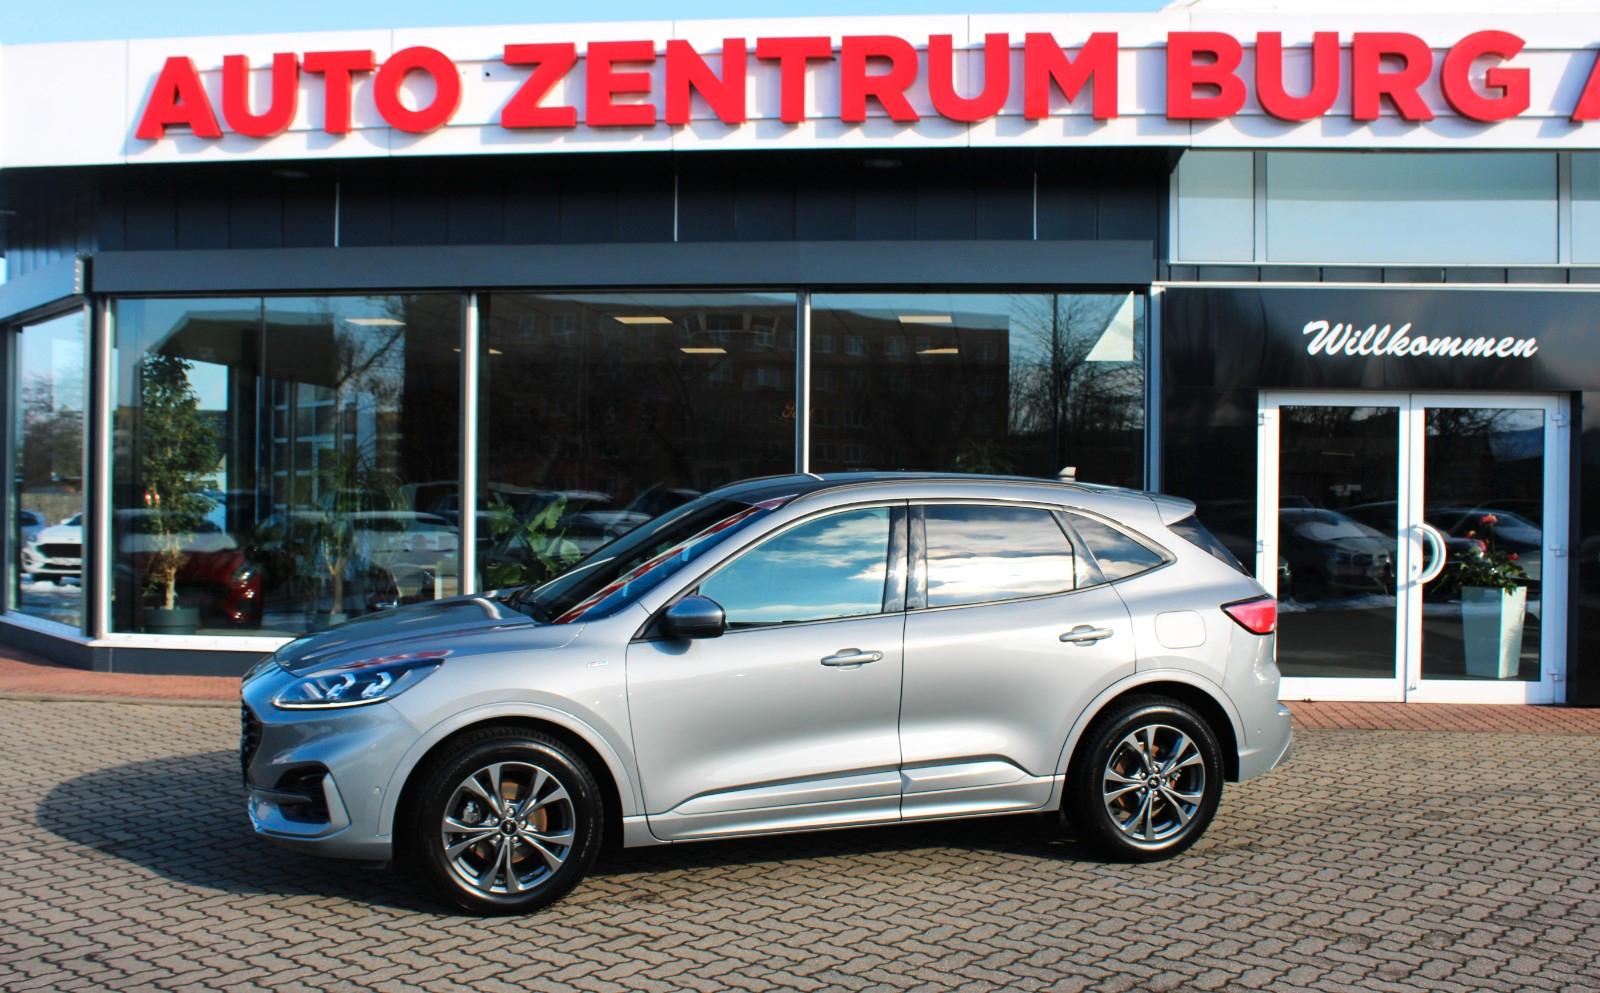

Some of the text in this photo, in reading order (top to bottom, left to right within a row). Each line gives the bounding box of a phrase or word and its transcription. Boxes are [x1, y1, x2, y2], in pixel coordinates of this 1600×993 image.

[136, 46, 461, 140] AUTO
[501, 32, 1119, 129] ZENTRUM
[1166, 30, 1530, 123] BURG
[1303, 320, 1537, 358] Willkommen
